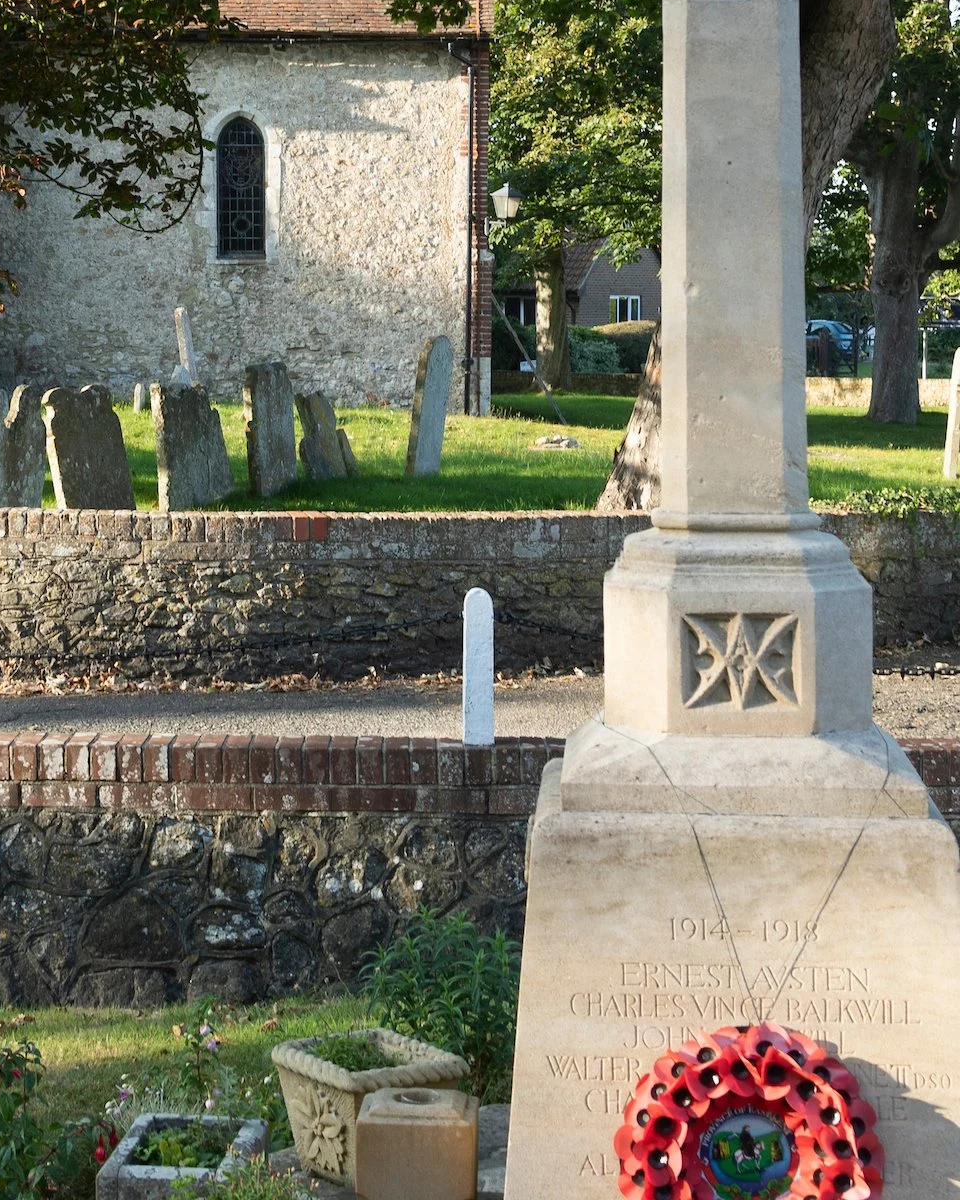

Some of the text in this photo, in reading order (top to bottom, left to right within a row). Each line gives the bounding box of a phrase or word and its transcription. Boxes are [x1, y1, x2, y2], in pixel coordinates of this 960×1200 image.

[669, 915, 731, 941] 1914
[762, 918, 821, 943] 1918
[620, 961, 741, 990] ERNEST
[569, 991, 922, 1026] CHARLES VINCE BALKWILL
[545, 1054, 642, 1083] WALTER
